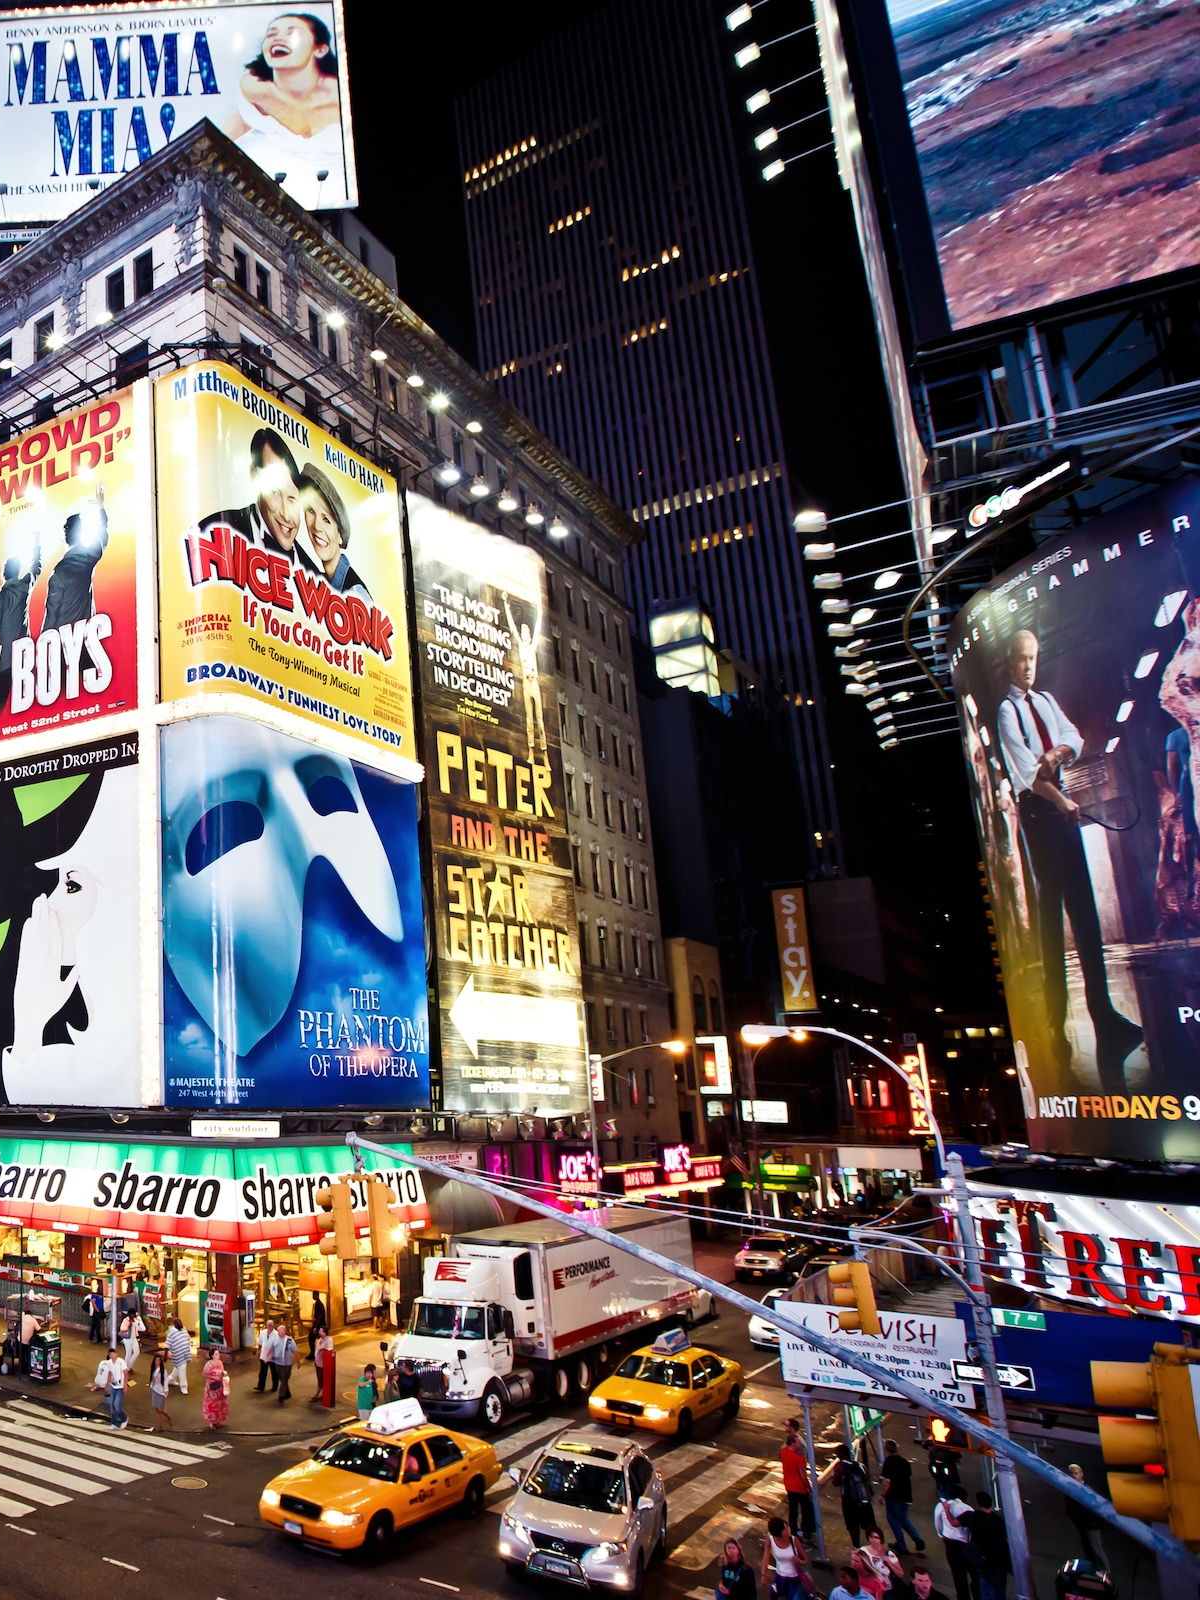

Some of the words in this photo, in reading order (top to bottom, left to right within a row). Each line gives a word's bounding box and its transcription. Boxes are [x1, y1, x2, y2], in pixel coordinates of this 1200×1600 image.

[6, 26, 42, 38] BENNY
[44, 22, 110, 35] ANDERSSON
[115, 22, 125, 31] &
[128, 18, 166, 30] BJÖRN
[4, 31, 221, 106] MAMMA
[50, 102, 176, 177] MIA!
[28, 183, 68, 194] SMASH
[0, 231, 18, 239] city
[242, 392, 310, 449] BRODERICK
[325, 441, 347, 475] Kelli
[348, 457, 386, 495] O'HARA
[8, 502, 35, 515] Times
[989, 569, 1031, 603] ORIGINAL
[1031, 545, 1072, 576] SERIES
[1007, 514, 1191, 613] GRAMMER
[186, 526, 295, 613] NICE
[294, 566, 394, 661] WORK
[184, 613, 232, 627] IMPERIAL
[423, 600, 512, 650] EXHILARATING
[464, 596, 500, 625] MOST
[181, 637, 195, 648] 249
[195, 636, 205, 647] W.
[206, 634, 224, 645] 45th
[225, 633, 235, 643] St.
[184, 622, 230, 637] THEATRE
[243, 595, 258, 628] If
[261, 609, 291, 642] You
[293, 624, 321, 655] Can
[323, 640, 351, 667] Get
[351, 652, 365, 677] It
[435, 624, 505, 667] BROADWAY
[11, 614, 112, 715] BOYS
[248, 636, 267, 657] The
[268, 645, 328, 685] Tony-Winning
[329, 671, 361, 699] Musical
[427, 642, 515, 690] STORYTELLING
[434, 666, 449, 687] IN
[2, 722, 28, 736] West
[31, 715, 60, 728] 52nd
[62, 704, 101, 721] Street
[186, 662, 285, 701] BROADWAY'S
[288, 690, 341, 723] FUNNIEST
[343, 710, 370, 736] LOVE
[372, 723, 403, 748] STORY
[437, 730, 555, 818] PETER
[451, 814, 497, 853] AND
[503, 826, 550, 865] THE
[450, 916, 577, 976] CATCHER
[780, 894, 811, 998] stay.
[349, 987, 380, 1011] THE
[297, 1009, 427, 1055] PHANTOM
[309, 1053, 331, 1078] OF
[335, 1054, 369, 1077] THE
[370, 1054, 419, 1079] OPERA
[176, 1077, 215, 1088] MAJESTIC
[217, 1077, 255, 1087] THEATRE
[178, 1089, 190, 1097] 247
[192, 1089, 207, 1097] West
[209, 1089, 226, 1097] 44th
[903, 1055, 931, 1128] PARK
[1080, 1095, 1182, 1120] FRIDAYS
[204, 1125, 223, 1134] city
[228, 1124, 268, 1133] outdoor
[559, 1150, 603, 1181] JOE'S
[664, 1144, 691, 1172] JOE'S
[93, 1161, 221, 1219] sbarro
[564, 1256, 611, 1280] PERFORMANCE
[1009, 1312, 1020, 1325] 7
[1028, 1314, 1039, 1322] AV
[787, 1343, 806, 1352] LIVE
[875, 1353, 910, 1366] 9:30pm
[892, 1344, 938, 1357] RESTAURANT
[889, 1367, 935, 1381] SPECIALS
